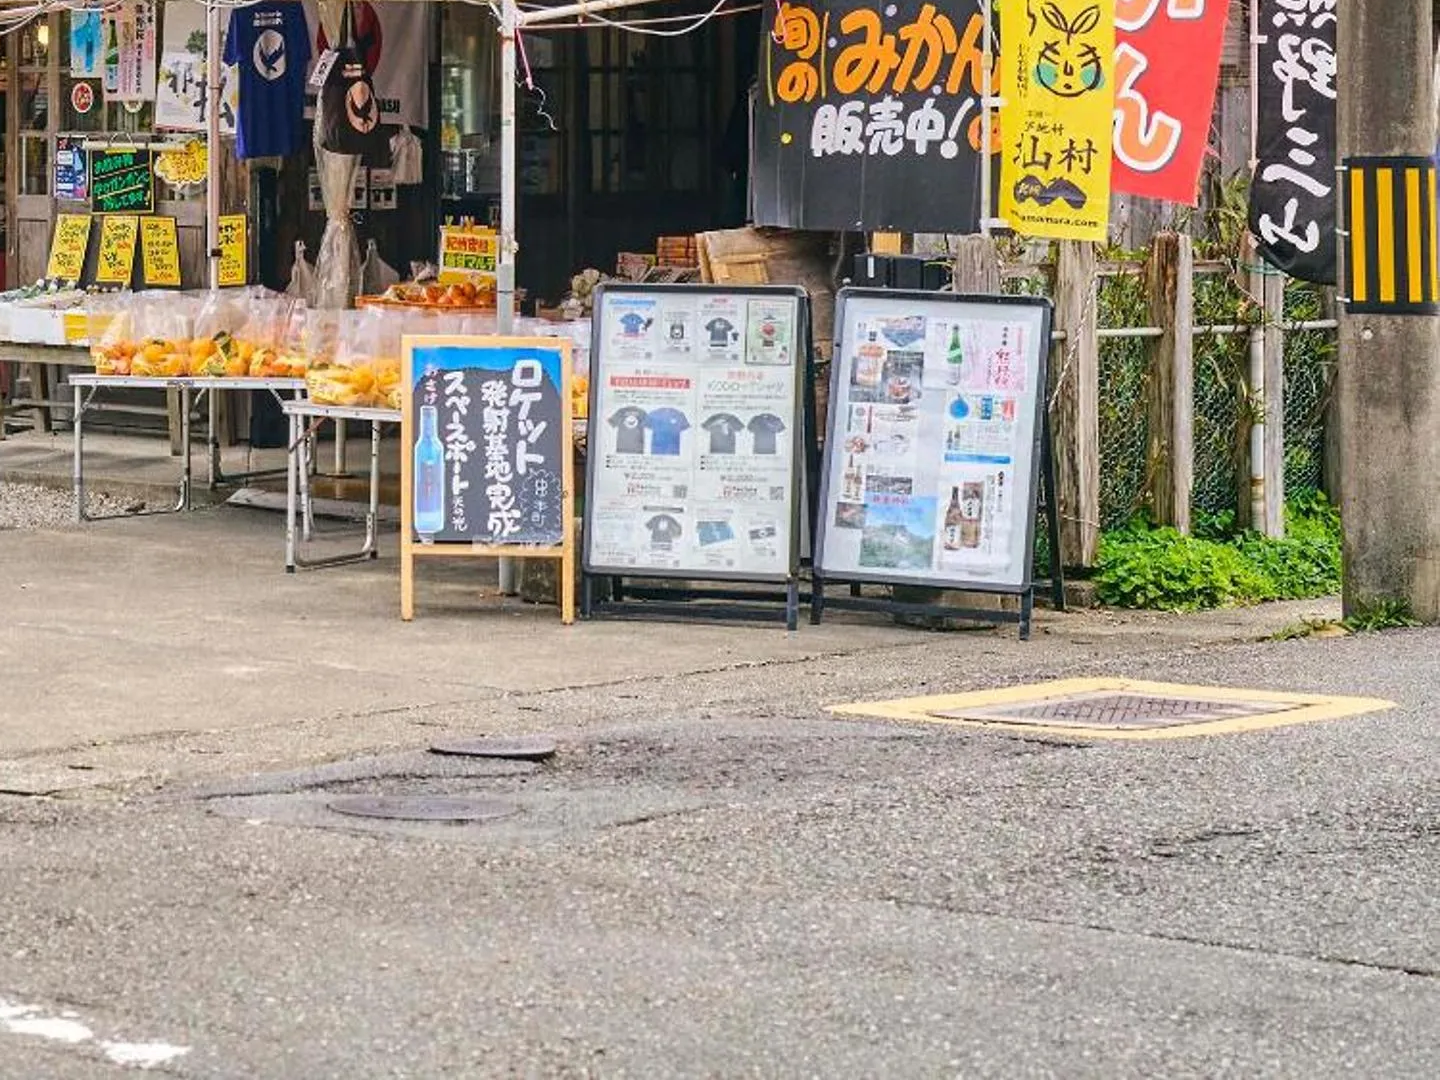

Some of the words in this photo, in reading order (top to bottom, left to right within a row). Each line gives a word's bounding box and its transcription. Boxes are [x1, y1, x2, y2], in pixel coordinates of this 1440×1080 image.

[772, 1, 820, 103] 旬の
[833, 3, 1001, 96] みかん
[811, 95, 975, 159] 販売中!
[443, 371, 477, 496] スペースポート
[480, 380, 522, 537] 発射基地完成
[510, 359, 547, 474] ロケット
